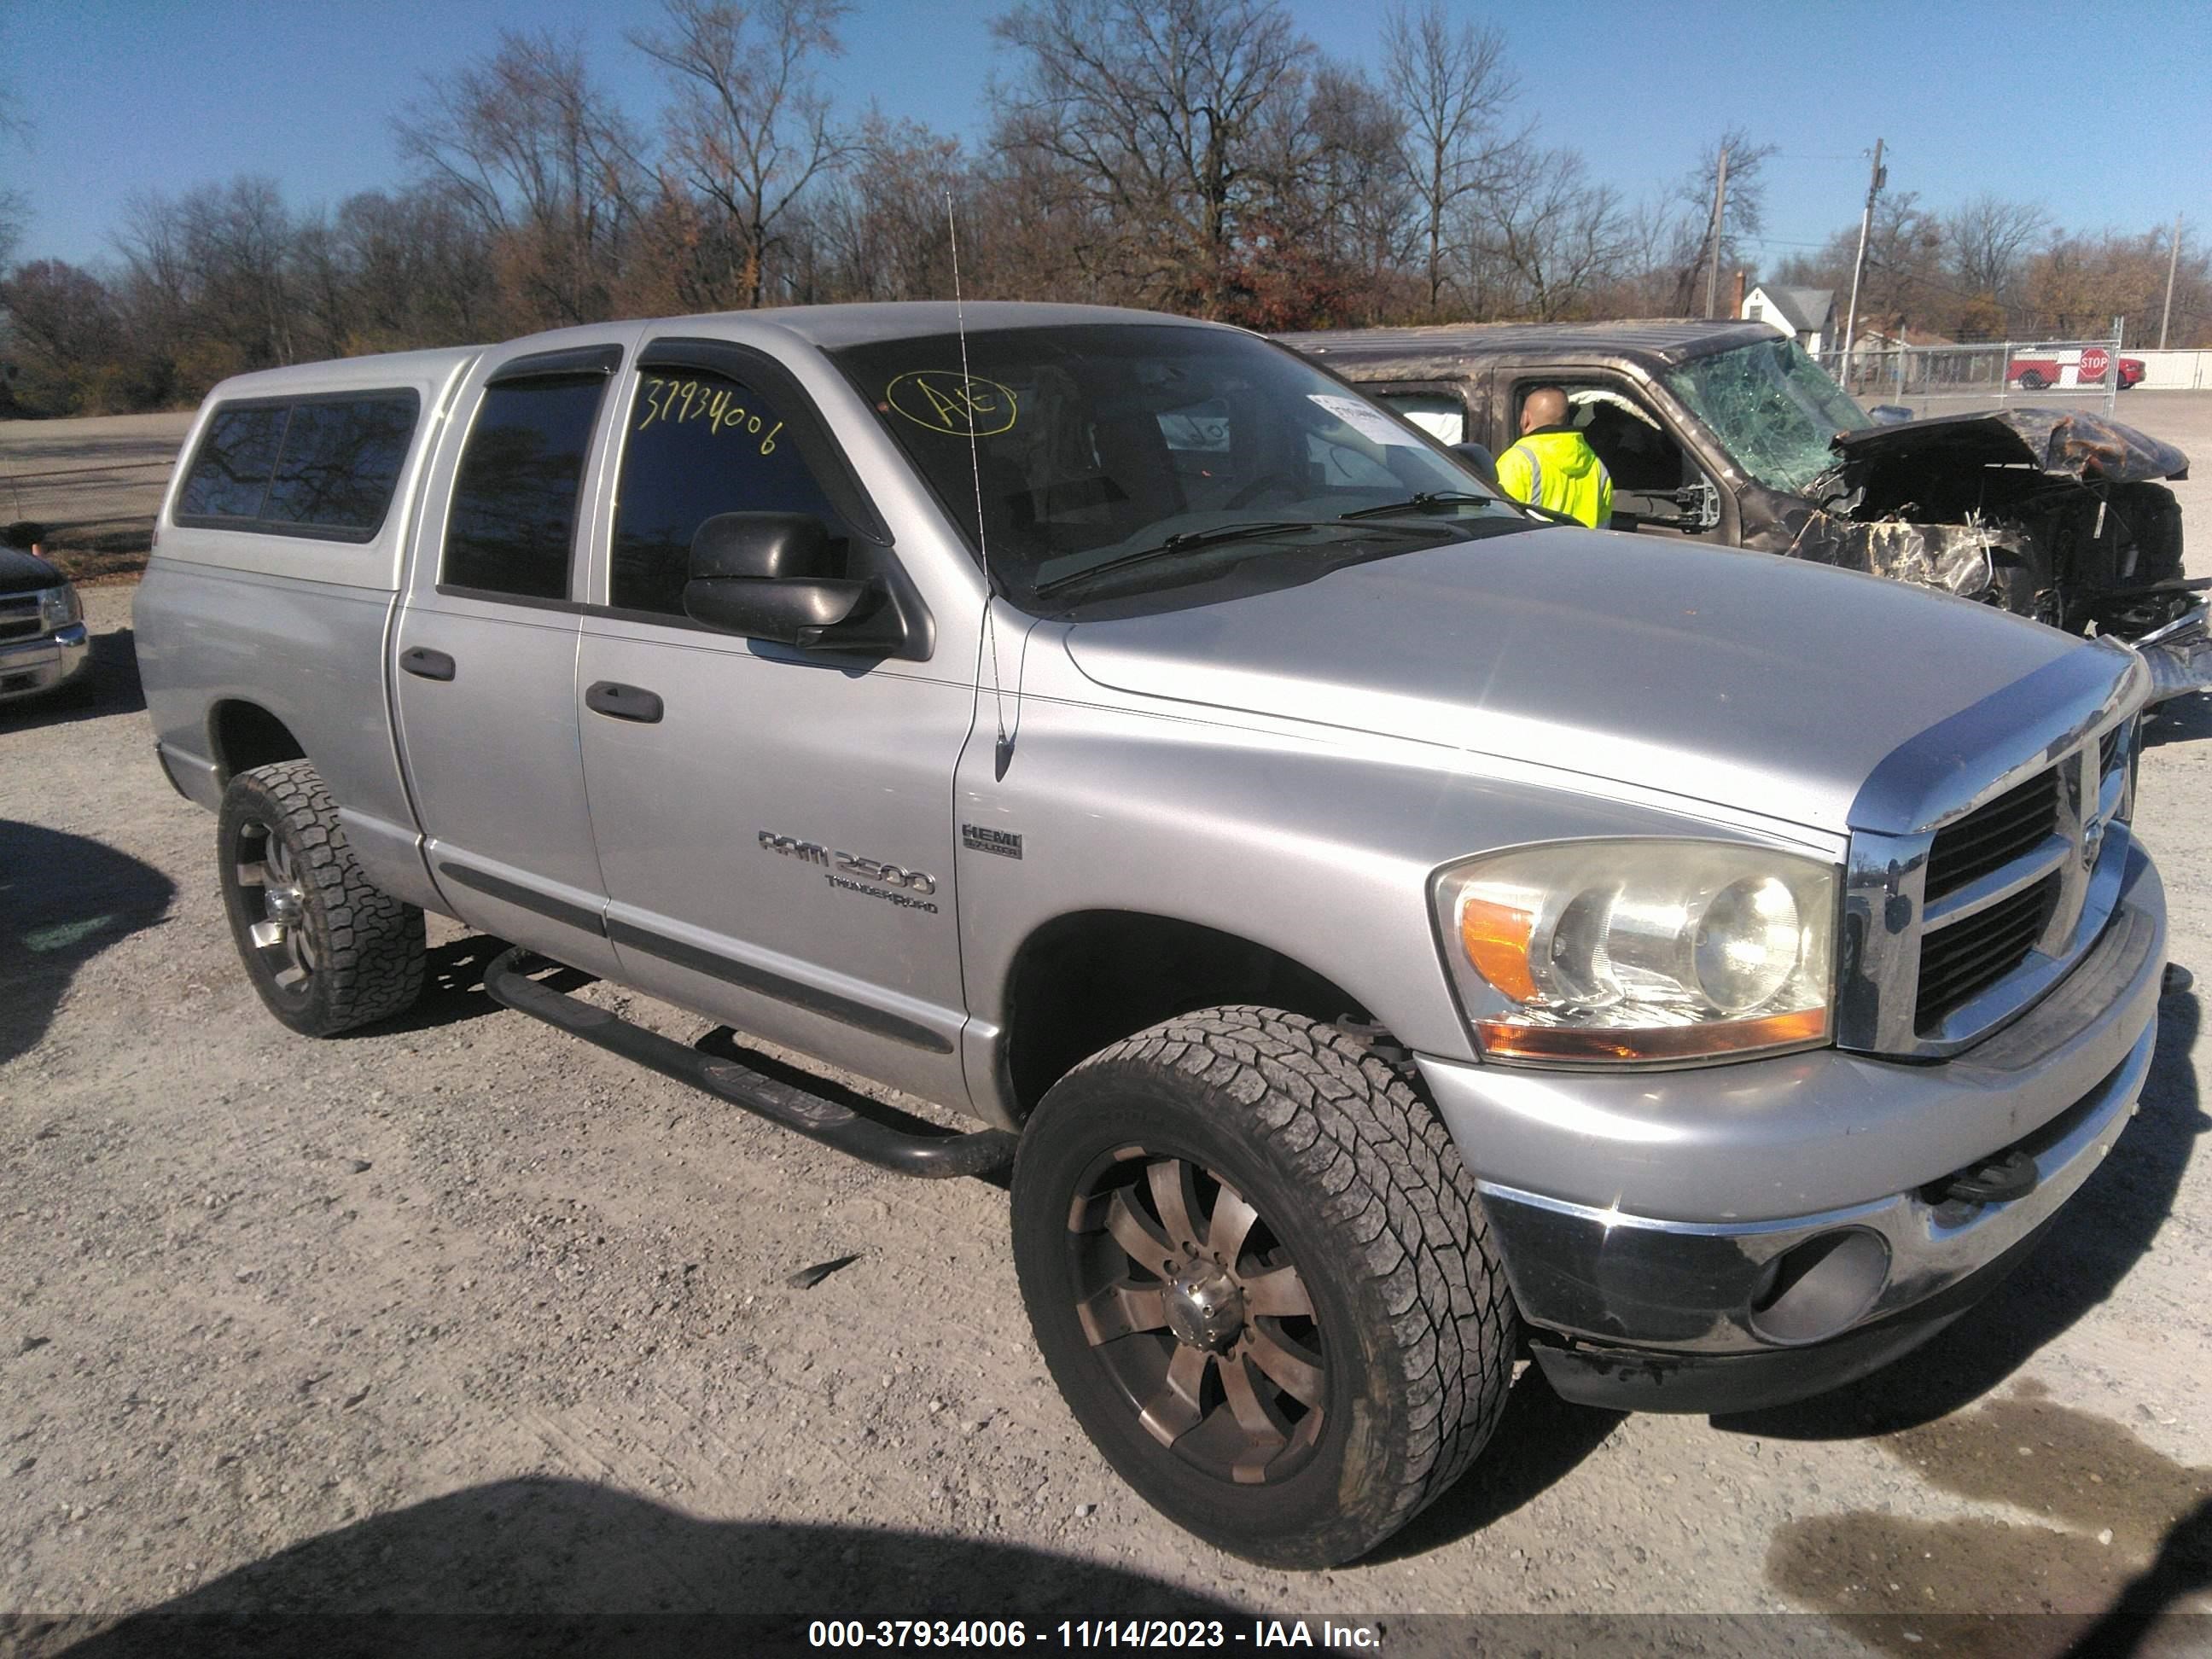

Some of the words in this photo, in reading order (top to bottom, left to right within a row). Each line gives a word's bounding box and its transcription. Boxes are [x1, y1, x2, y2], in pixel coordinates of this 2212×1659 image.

[2081, 357, 2108, 369] STOP
[638, 379, 783, 455] 37934006
[962, 824, 1019, 847] HEMI
[759, 830, 830, 867] RAM
[833, 851, 936, 895] 2500
